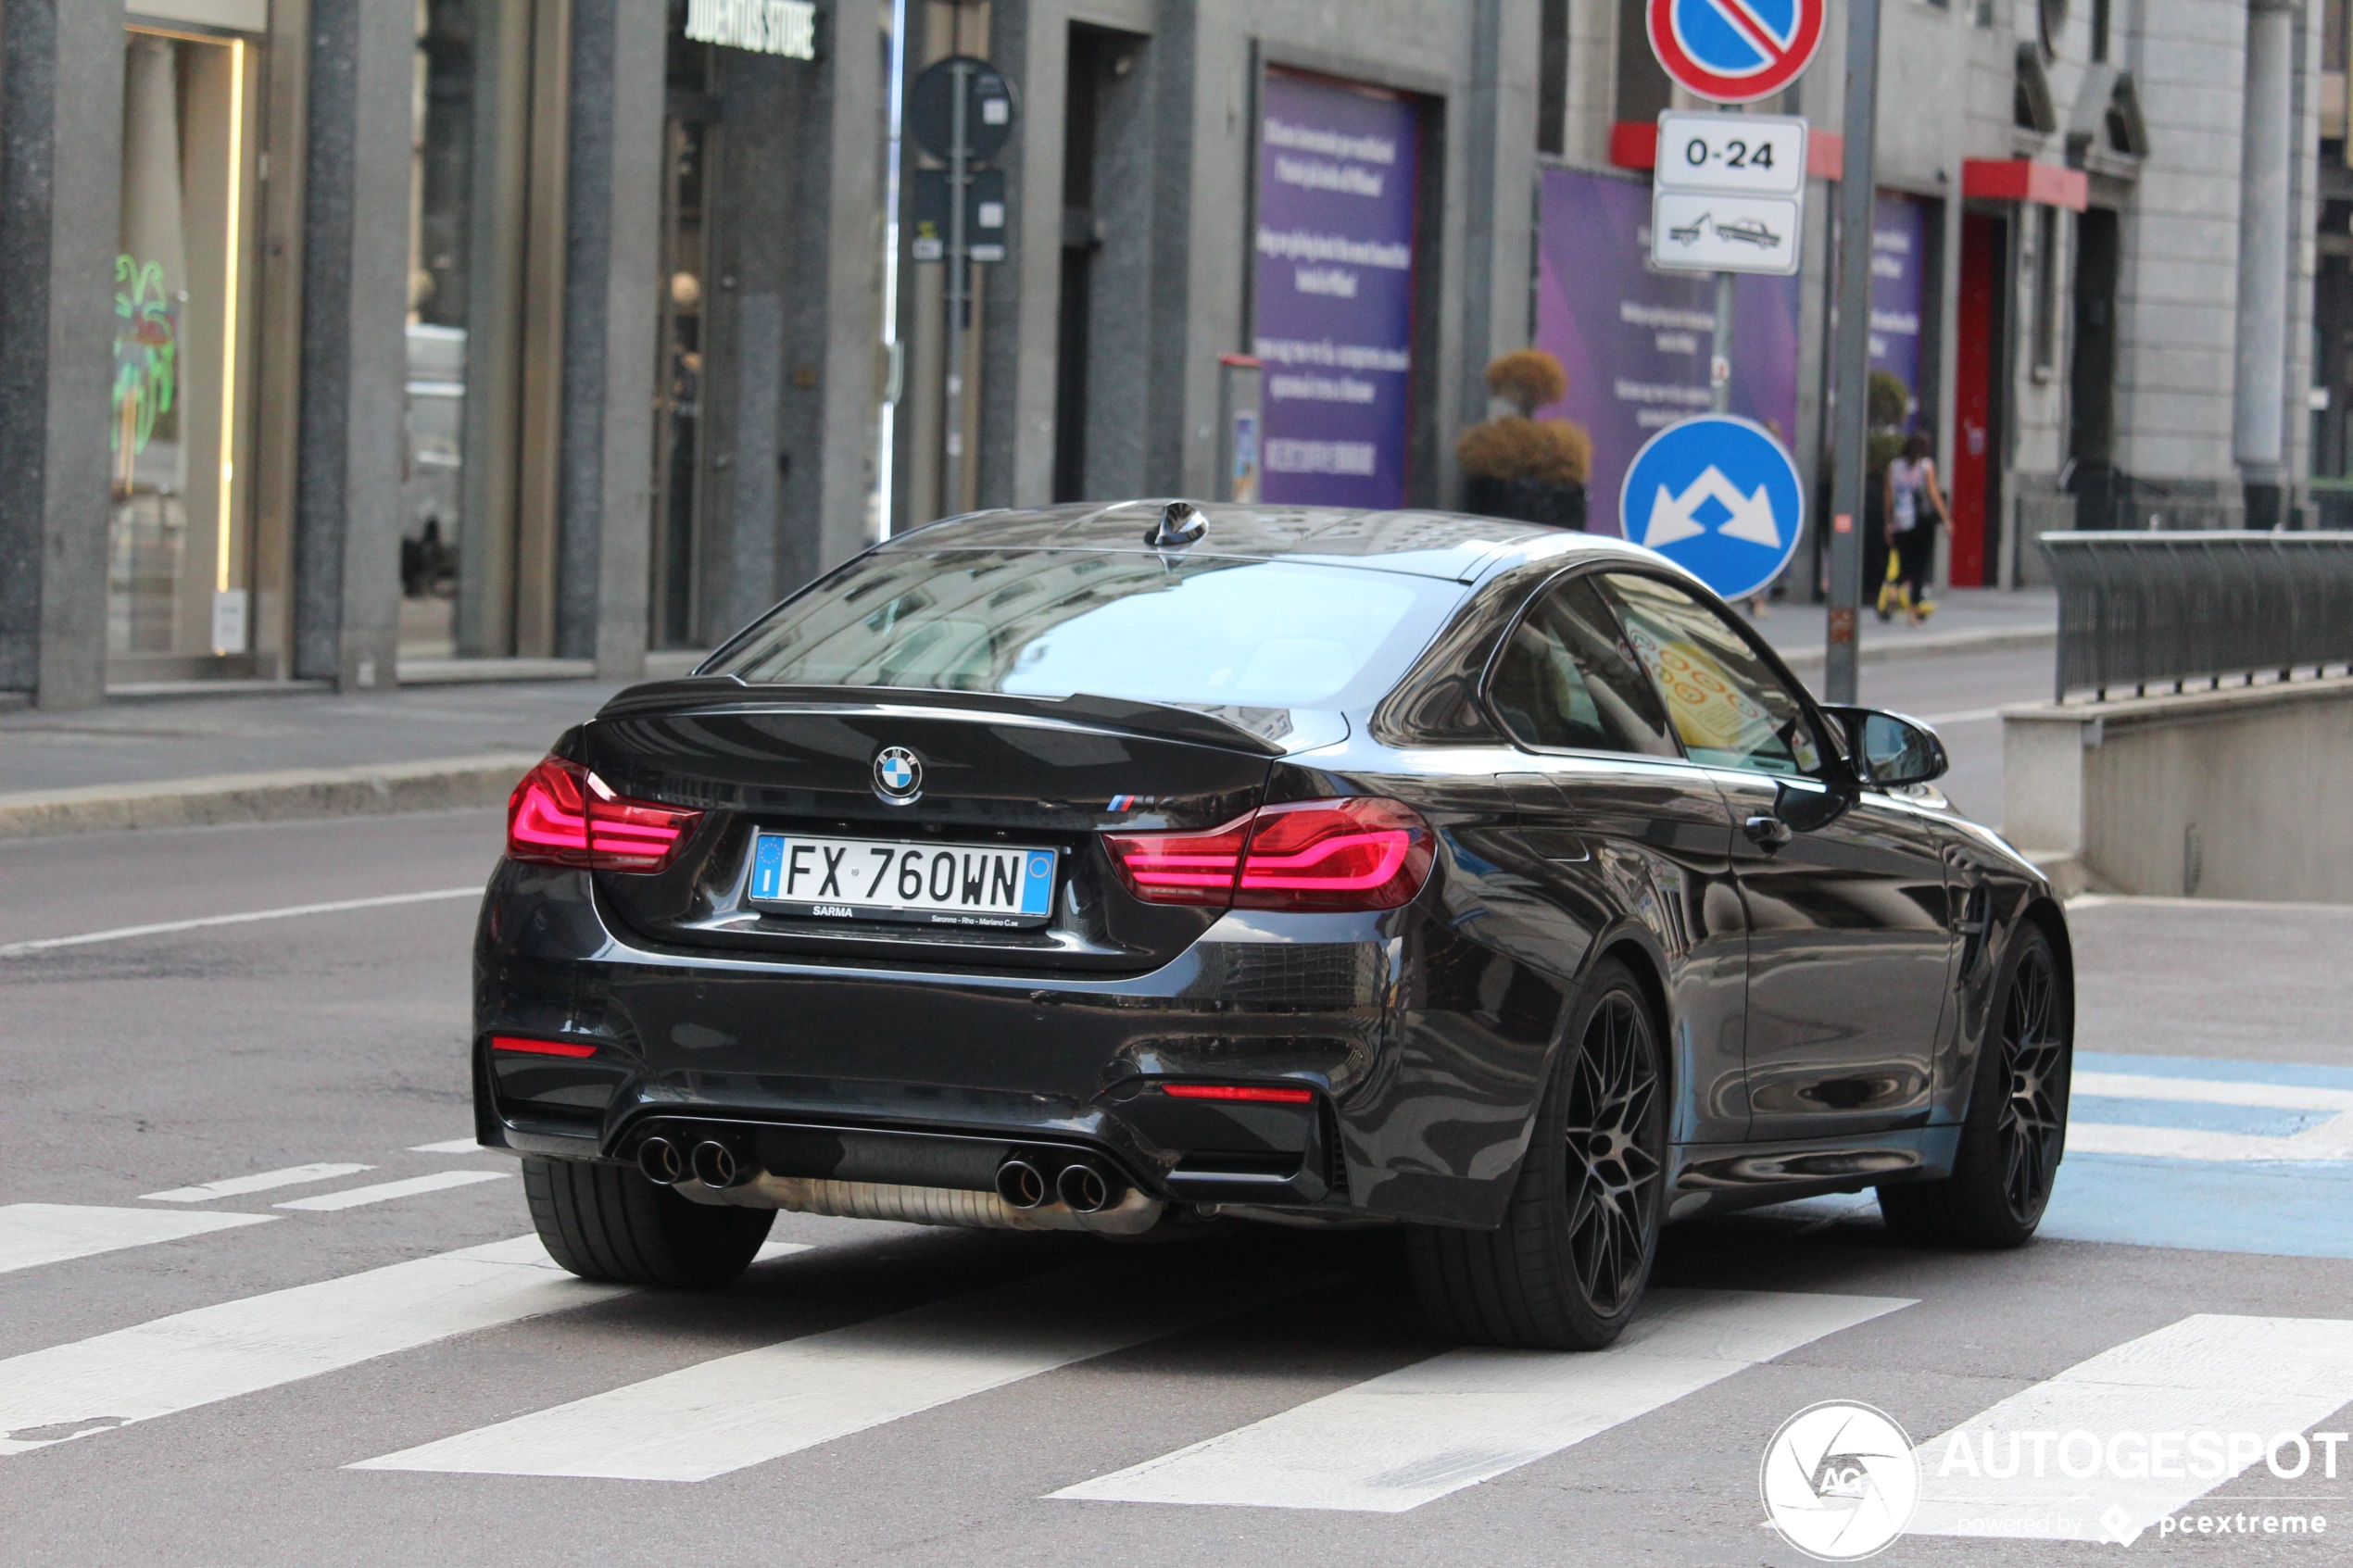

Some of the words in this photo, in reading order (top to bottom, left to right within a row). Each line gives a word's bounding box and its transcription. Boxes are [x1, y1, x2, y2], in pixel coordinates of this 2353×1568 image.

[1686, 138, 1773, 169] 0-24
[879, 748, 918, 766] BMW
[812, 906, 852, 918] SARMA
[931, 915, 957, 924] Saronno
[962, 917, 975, 925] Rho
[979, 918, 1003, 926] Mariano
